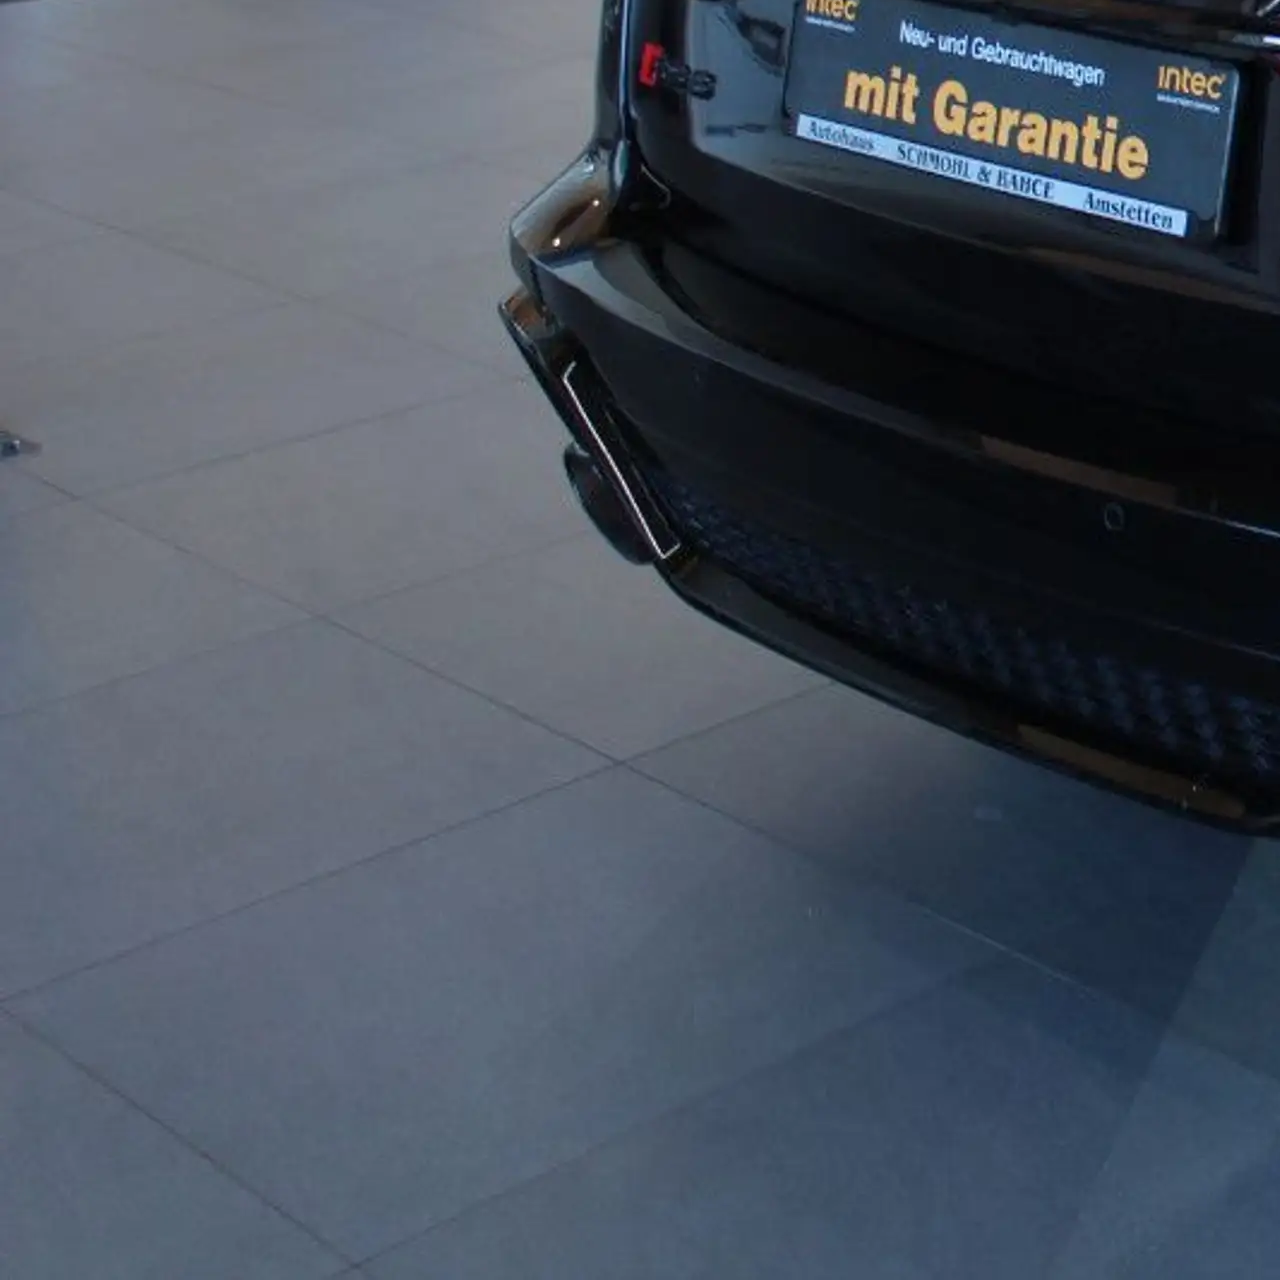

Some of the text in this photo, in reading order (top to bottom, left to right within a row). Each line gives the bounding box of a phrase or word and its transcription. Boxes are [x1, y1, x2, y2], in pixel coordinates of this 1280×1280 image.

[900, 20, 935, 48] Neu-
[938, 34, 968, 56] und
[808, 121, 875, 152] Autohaus
[977, 164, 992, 183] &
[1083, 191, 1173, 230] Amstetten
[844, 66, 1149, 181] mit Garantie
